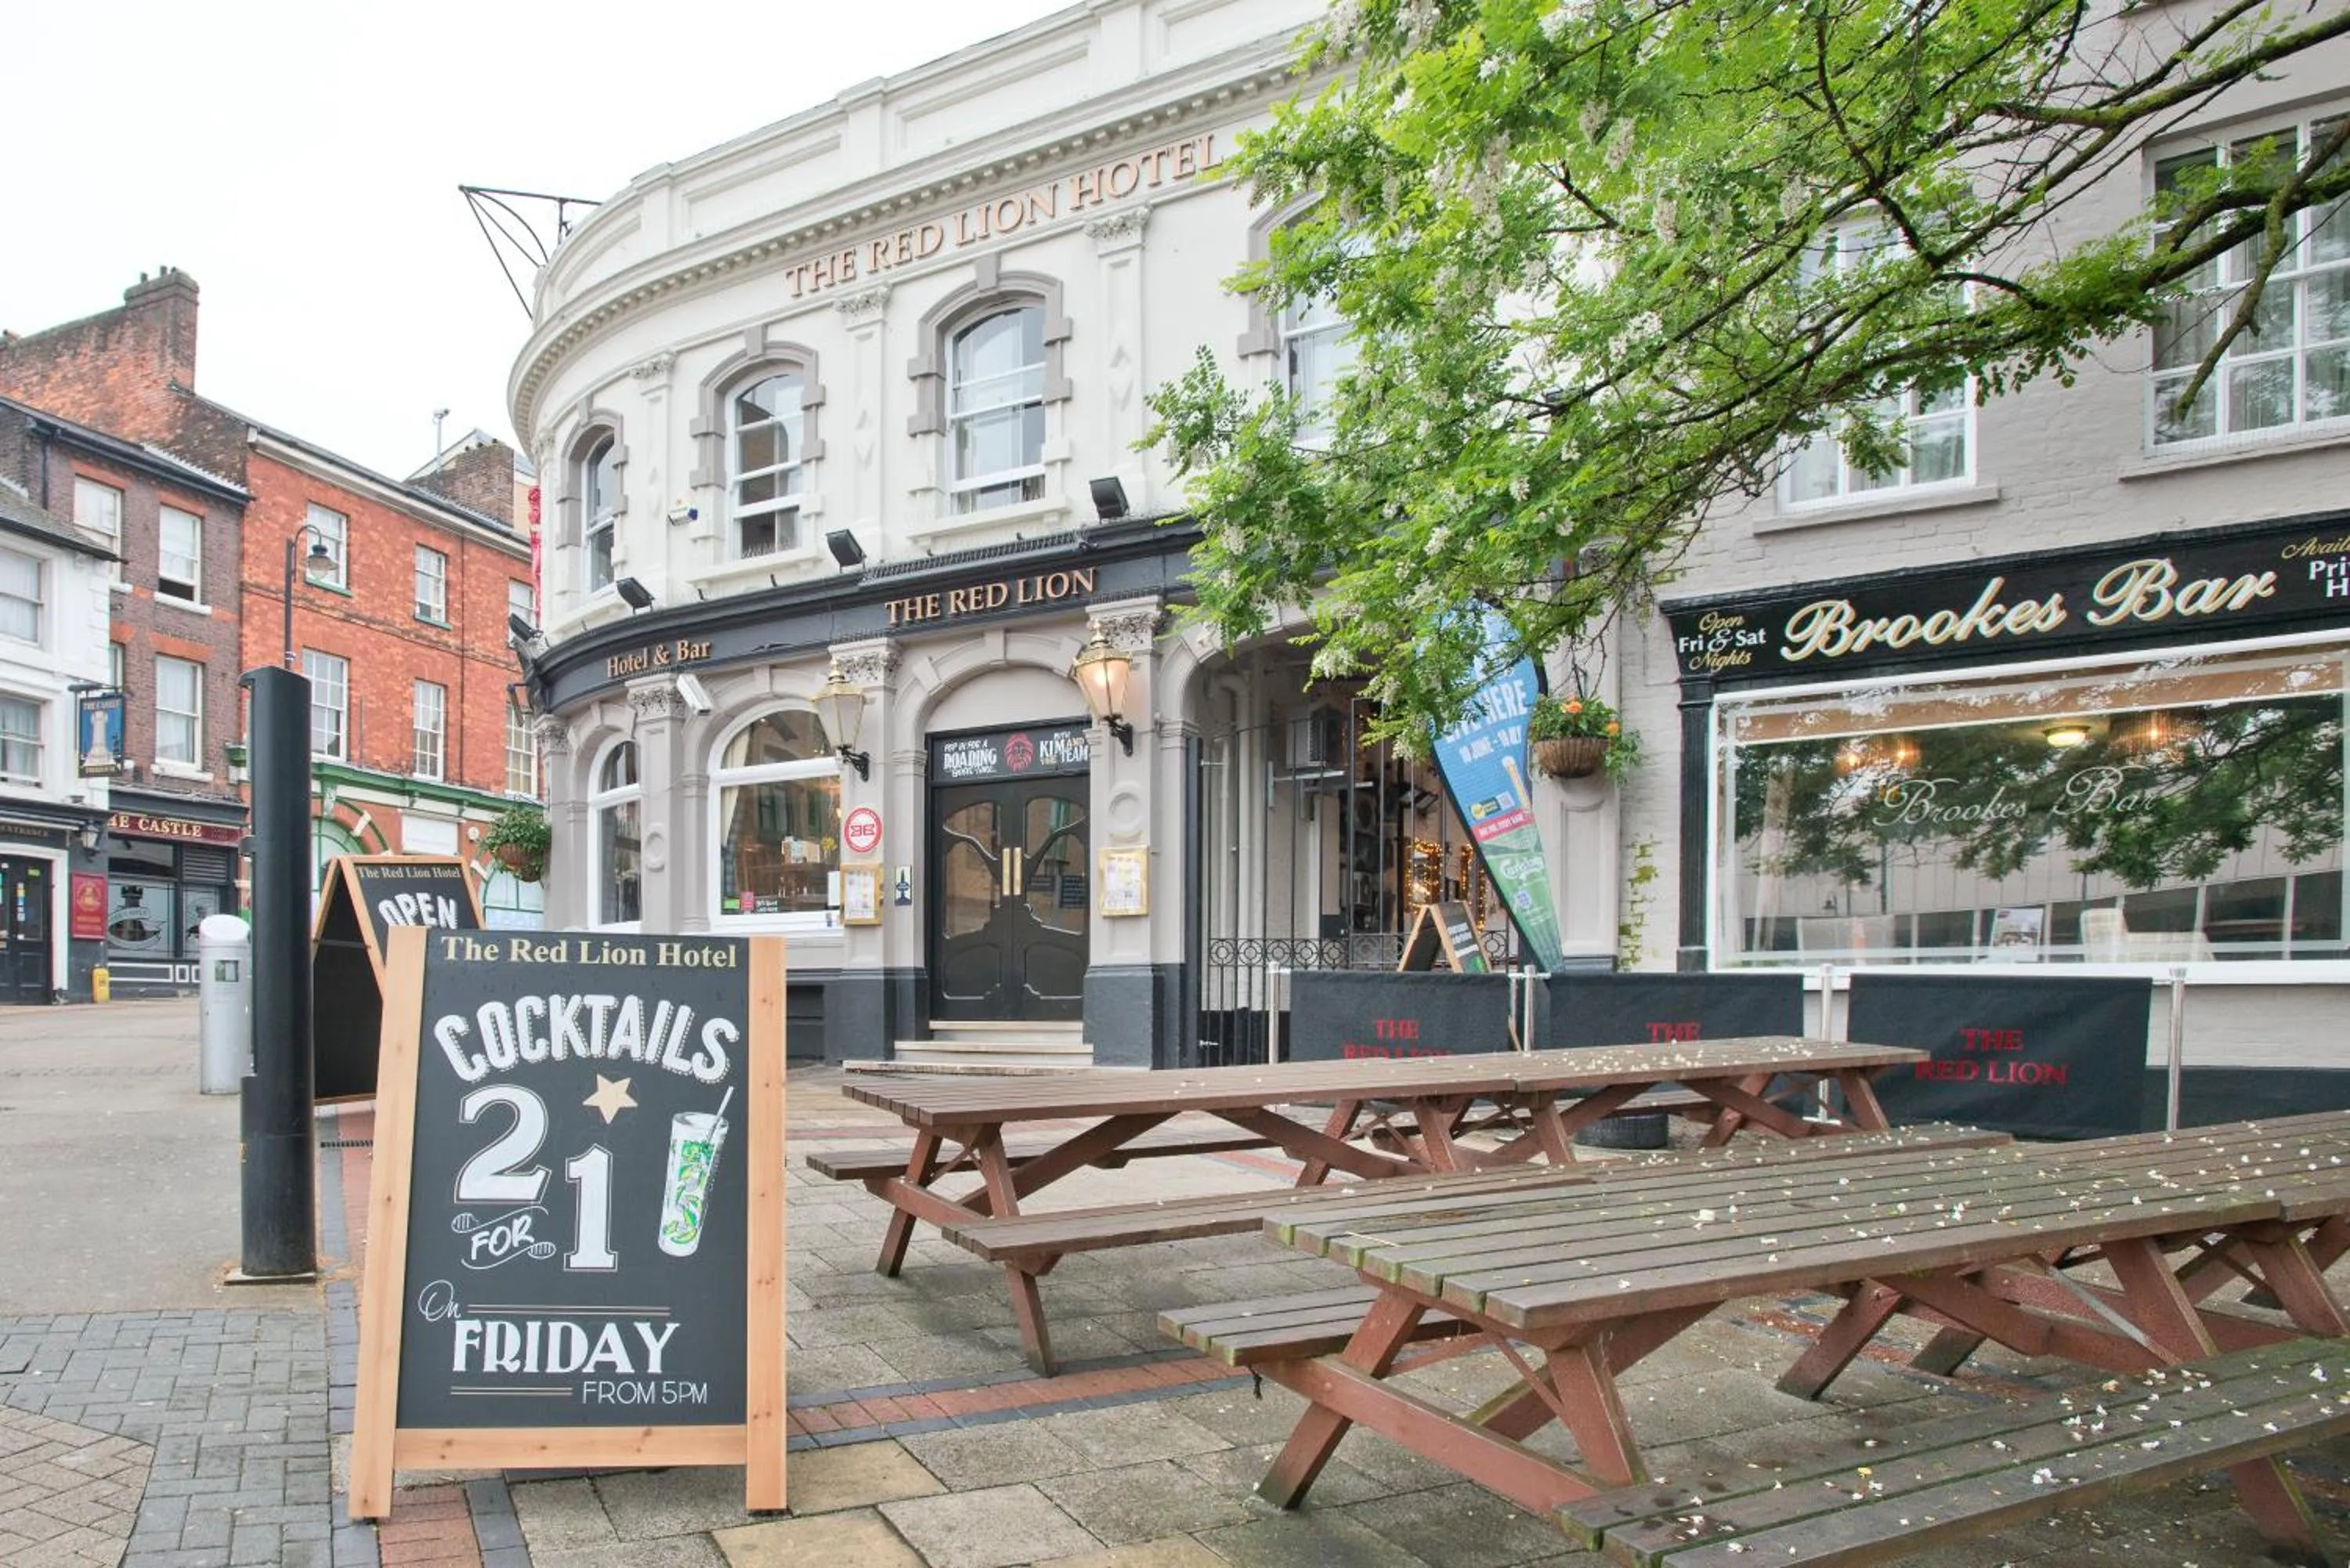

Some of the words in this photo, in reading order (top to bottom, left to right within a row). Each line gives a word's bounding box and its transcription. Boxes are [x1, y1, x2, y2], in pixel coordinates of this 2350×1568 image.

[786, 247, 857, 298] THE
[866, 224, 945, 274] RED
[954, 182, 1059, 247] LION
[1069, 134, 1224, 209] HOTEL
[2308, 555, 2350, 580] Pri
[884, 593, 941, 625] THE
[948, 581, 1009, 615] RED
[1018, 566, 1097, 603] LION
[1780, 576, 2067, 662] Brookes
[2087, 557, 2278, 628] Bar
[1698, 611, 1745, 635] Open
[1679, 634, 1705, 653] Fri
[1707, 628, 1734, 653] &
[1735, 628, 1766, 647] Sat
[606, 647, 649, 678] Hotel
[653, 645, 670, 665] &
[676, 639, 712, 663] Bar
[1688, 649, 1752, 674] Nights
[1039, 739, 1065, 757] KIM
[1061, 745, 1090, 764] TEAM
[1872, 778, 2027, 826] Brookes
[2052, 765, 2158, 815] Bar
[138, 818, 202, 837] CASTLE
[358, 866, 380, 879] The
[381, 866, 403, 879] Red
[405, 866, 431, 879] Lion
[432, 866, 461, 879] Hotel
[378, 891, 458, 930] OPEN
[441, 935, 499, 963] The
[509, 938, 567, 964] Red
[579, 940, 647, 966] Lion
[656, 942, 737, 969] Hotel
[433, 993, 740, 1084] COCKTAILS
[1376, 1019, 1419, 1039] THE
[1646, 1021, 1701, 1043] THE
[1959, 1028, 2024, 1051] THE
[1914, 1059, 1980, 1082] RED
[1987, 1060, 2068, 1086] LION
[454, 1083, 552, 1205] 2
[563, 1142, 619, 1273] 1
[471, 1214, 536, 1261] FOR
[418, 1279, 461, 1322] On
[452, 1319, 681, 1375] FRIDAY
[582, 1381, 655, 1404] FROM
[661, 1381, 709, 1404] 5PM
